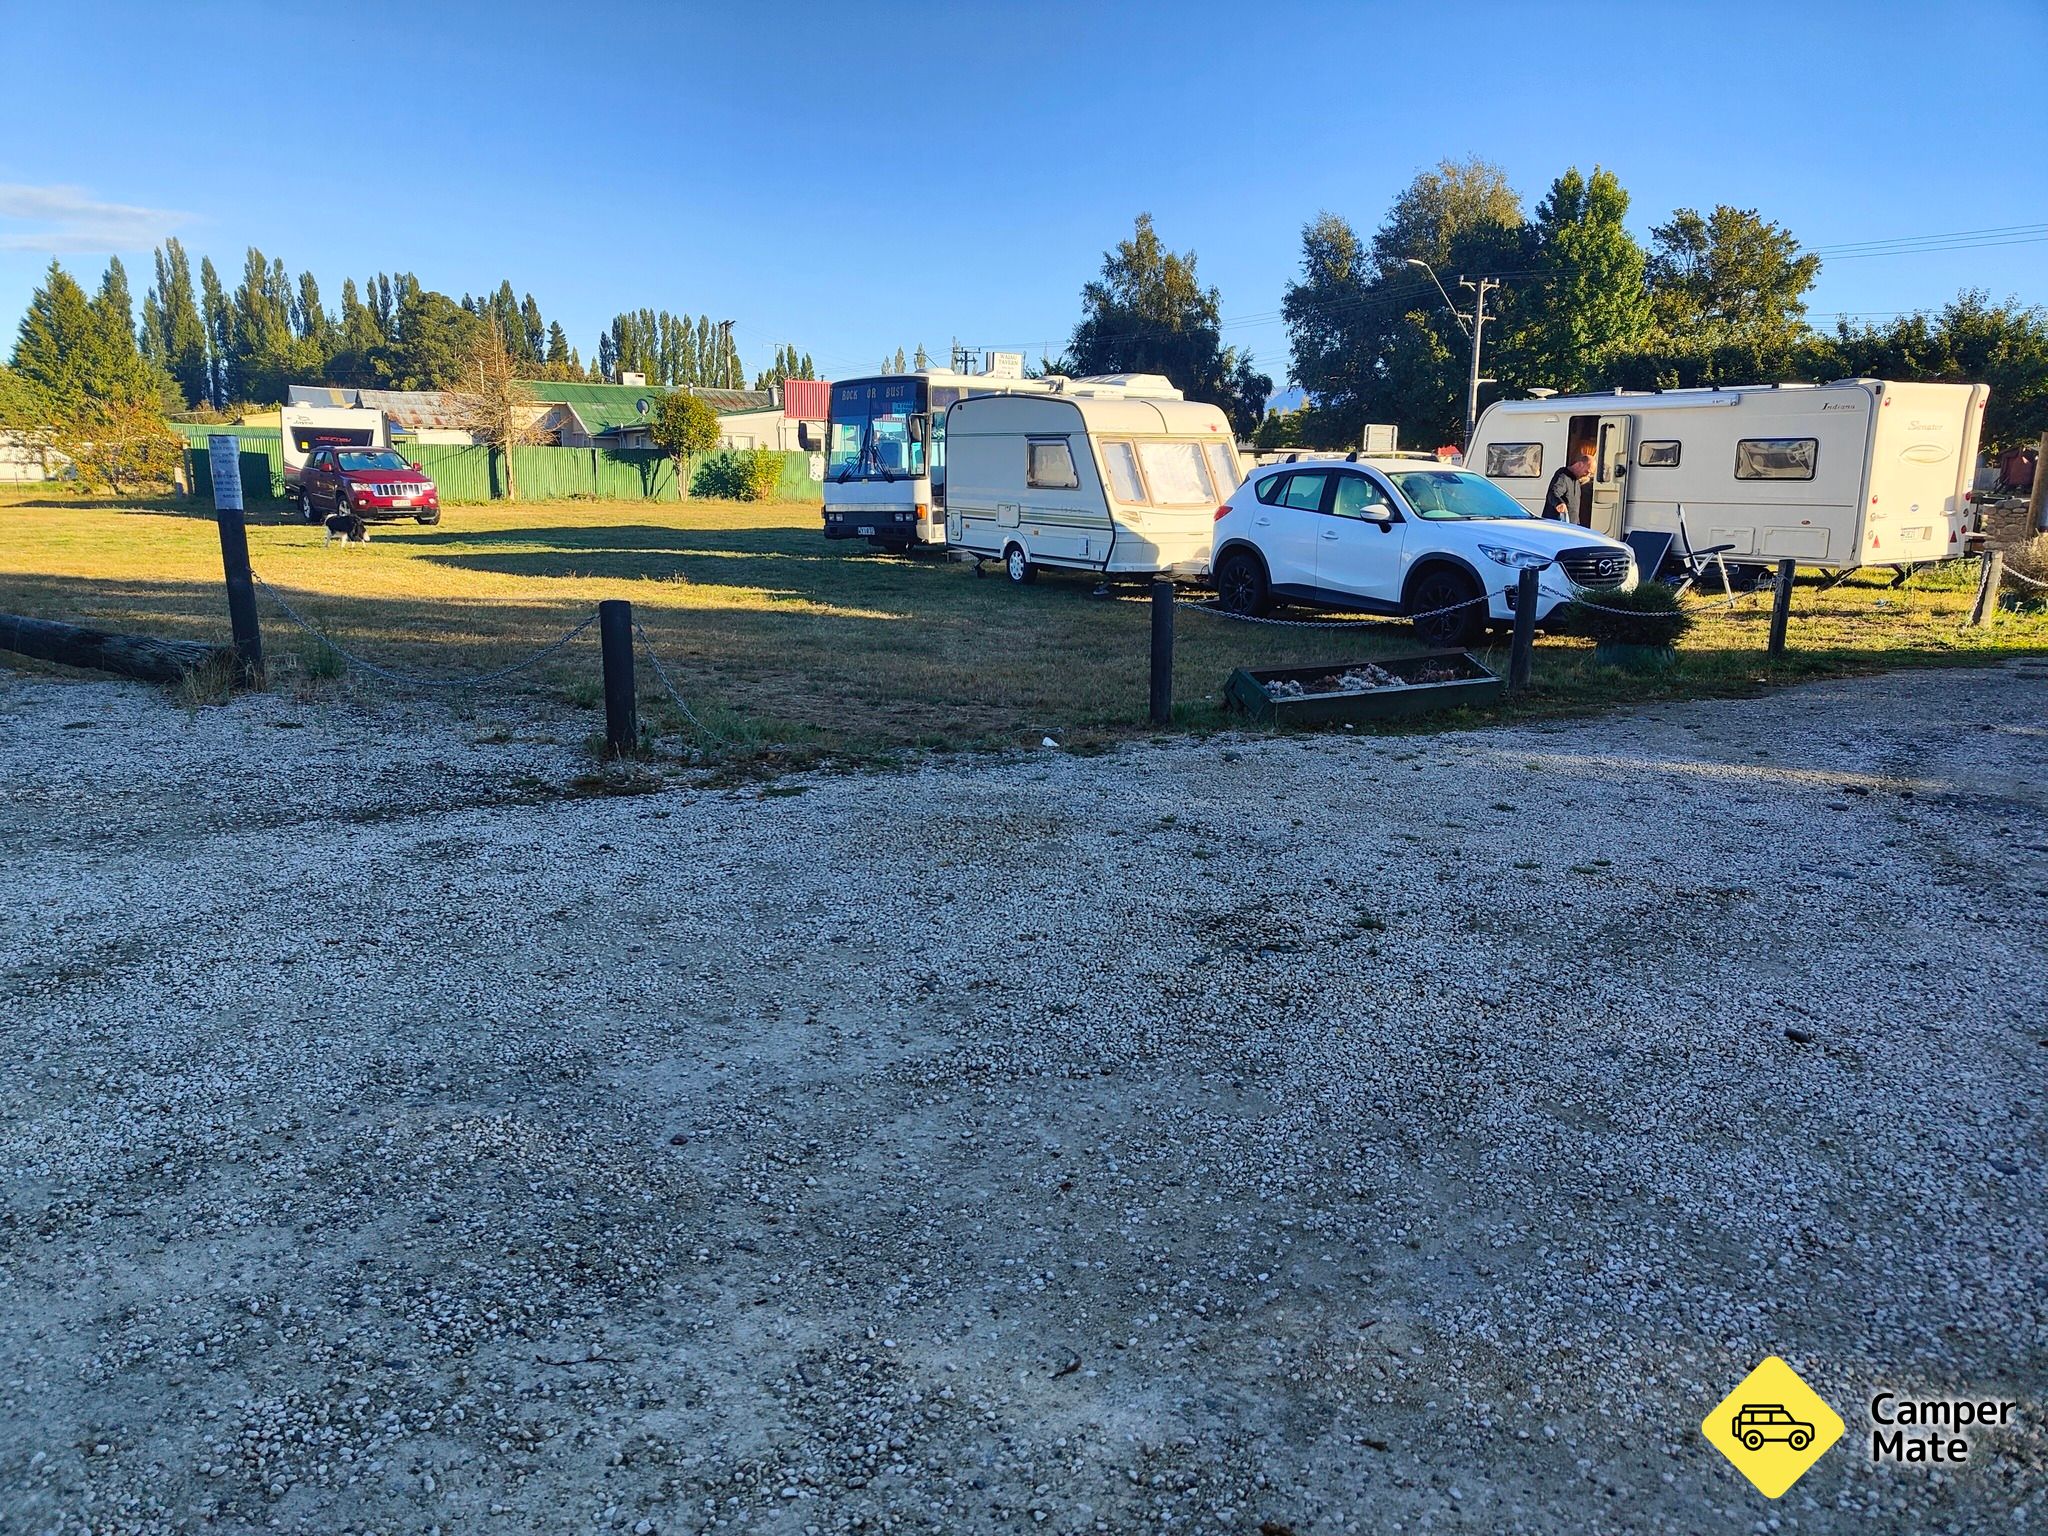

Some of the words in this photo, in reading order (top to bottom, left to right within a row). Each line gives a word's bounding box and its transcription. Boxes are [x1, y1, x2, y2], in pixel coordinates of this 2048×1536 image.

[866, 387, 877, 399] OR
[885, 385, 905, 398] BUST
[1821, 402, 1856, 411] Indiana
